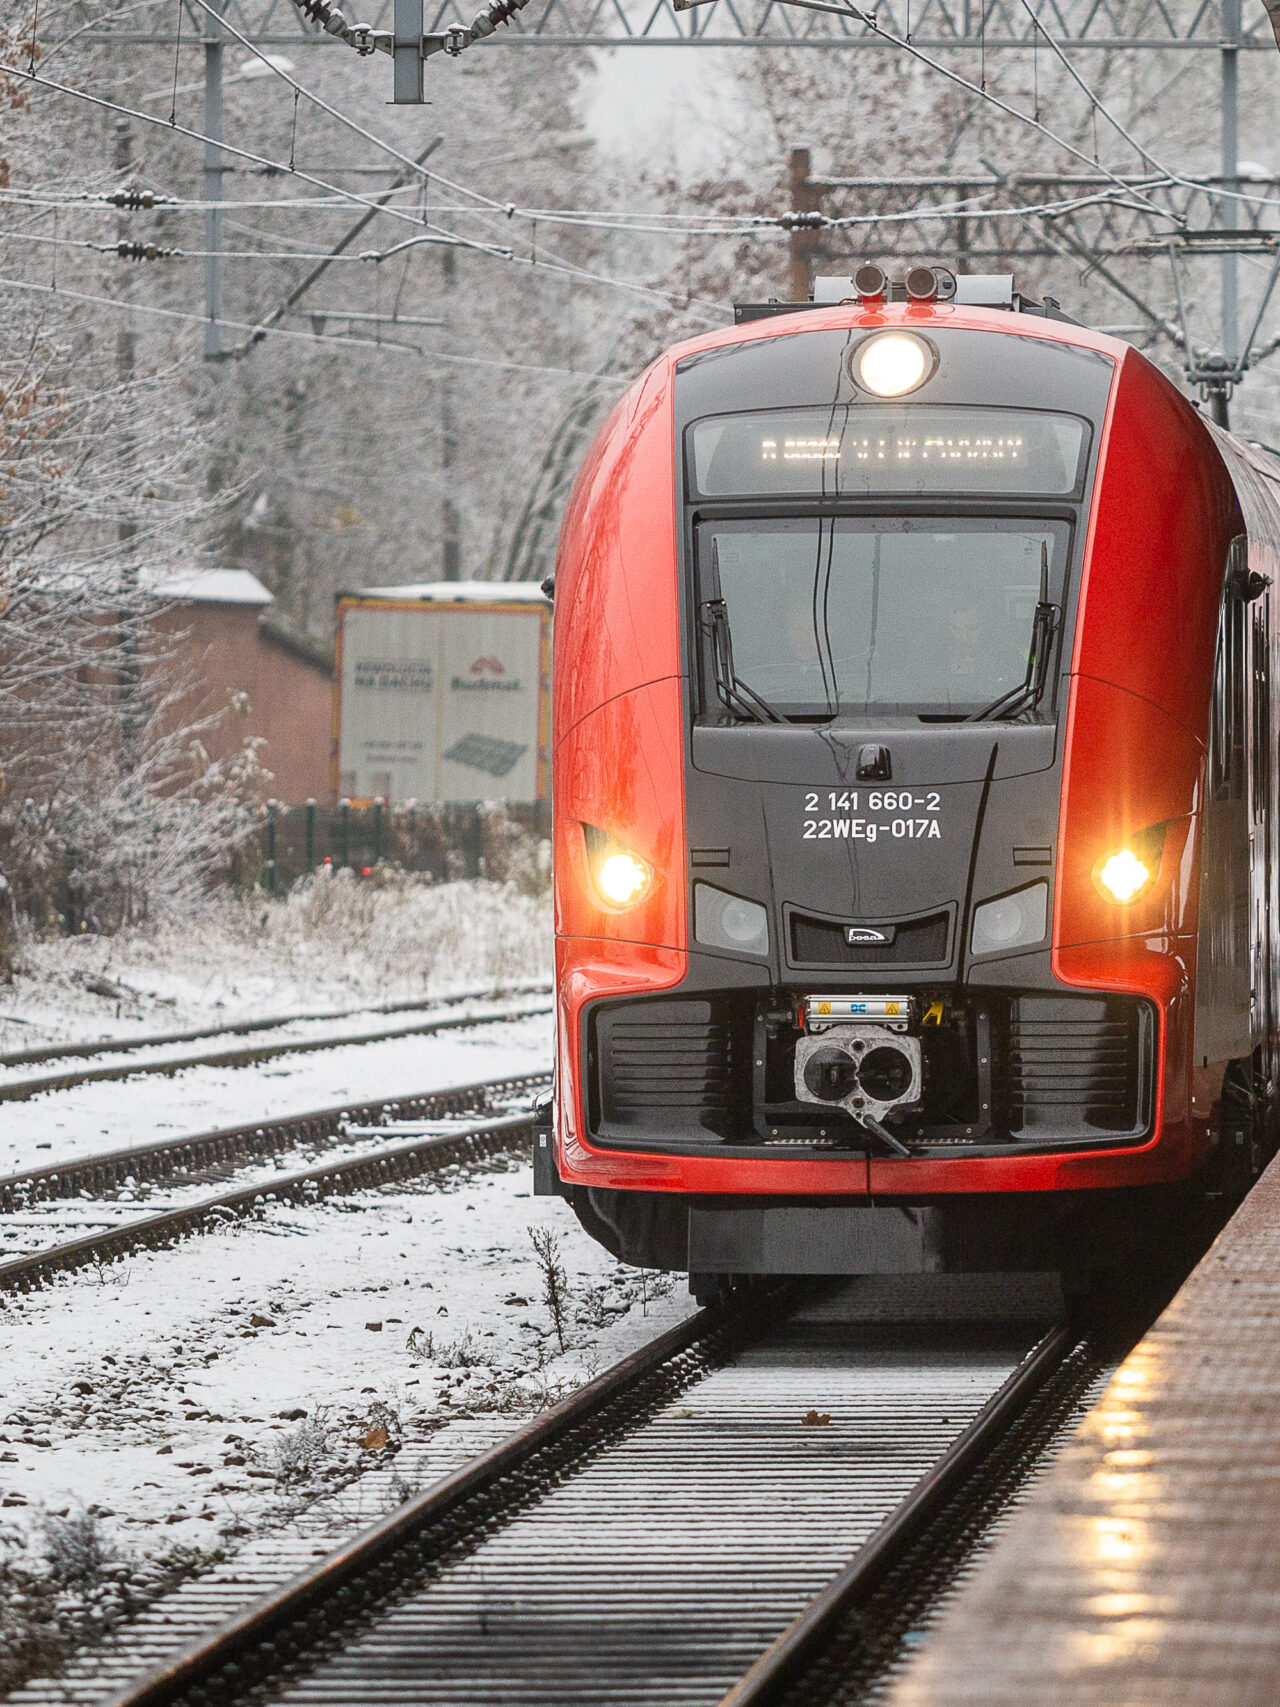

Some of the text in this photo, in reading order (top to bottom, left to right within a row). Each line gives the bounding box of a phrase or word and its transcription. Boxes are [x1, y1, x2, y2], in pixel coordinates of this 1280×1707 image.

[804, 791, 941, 812] 2 141 660-2
[803, 819, 941, 843] 22WEg-017A
